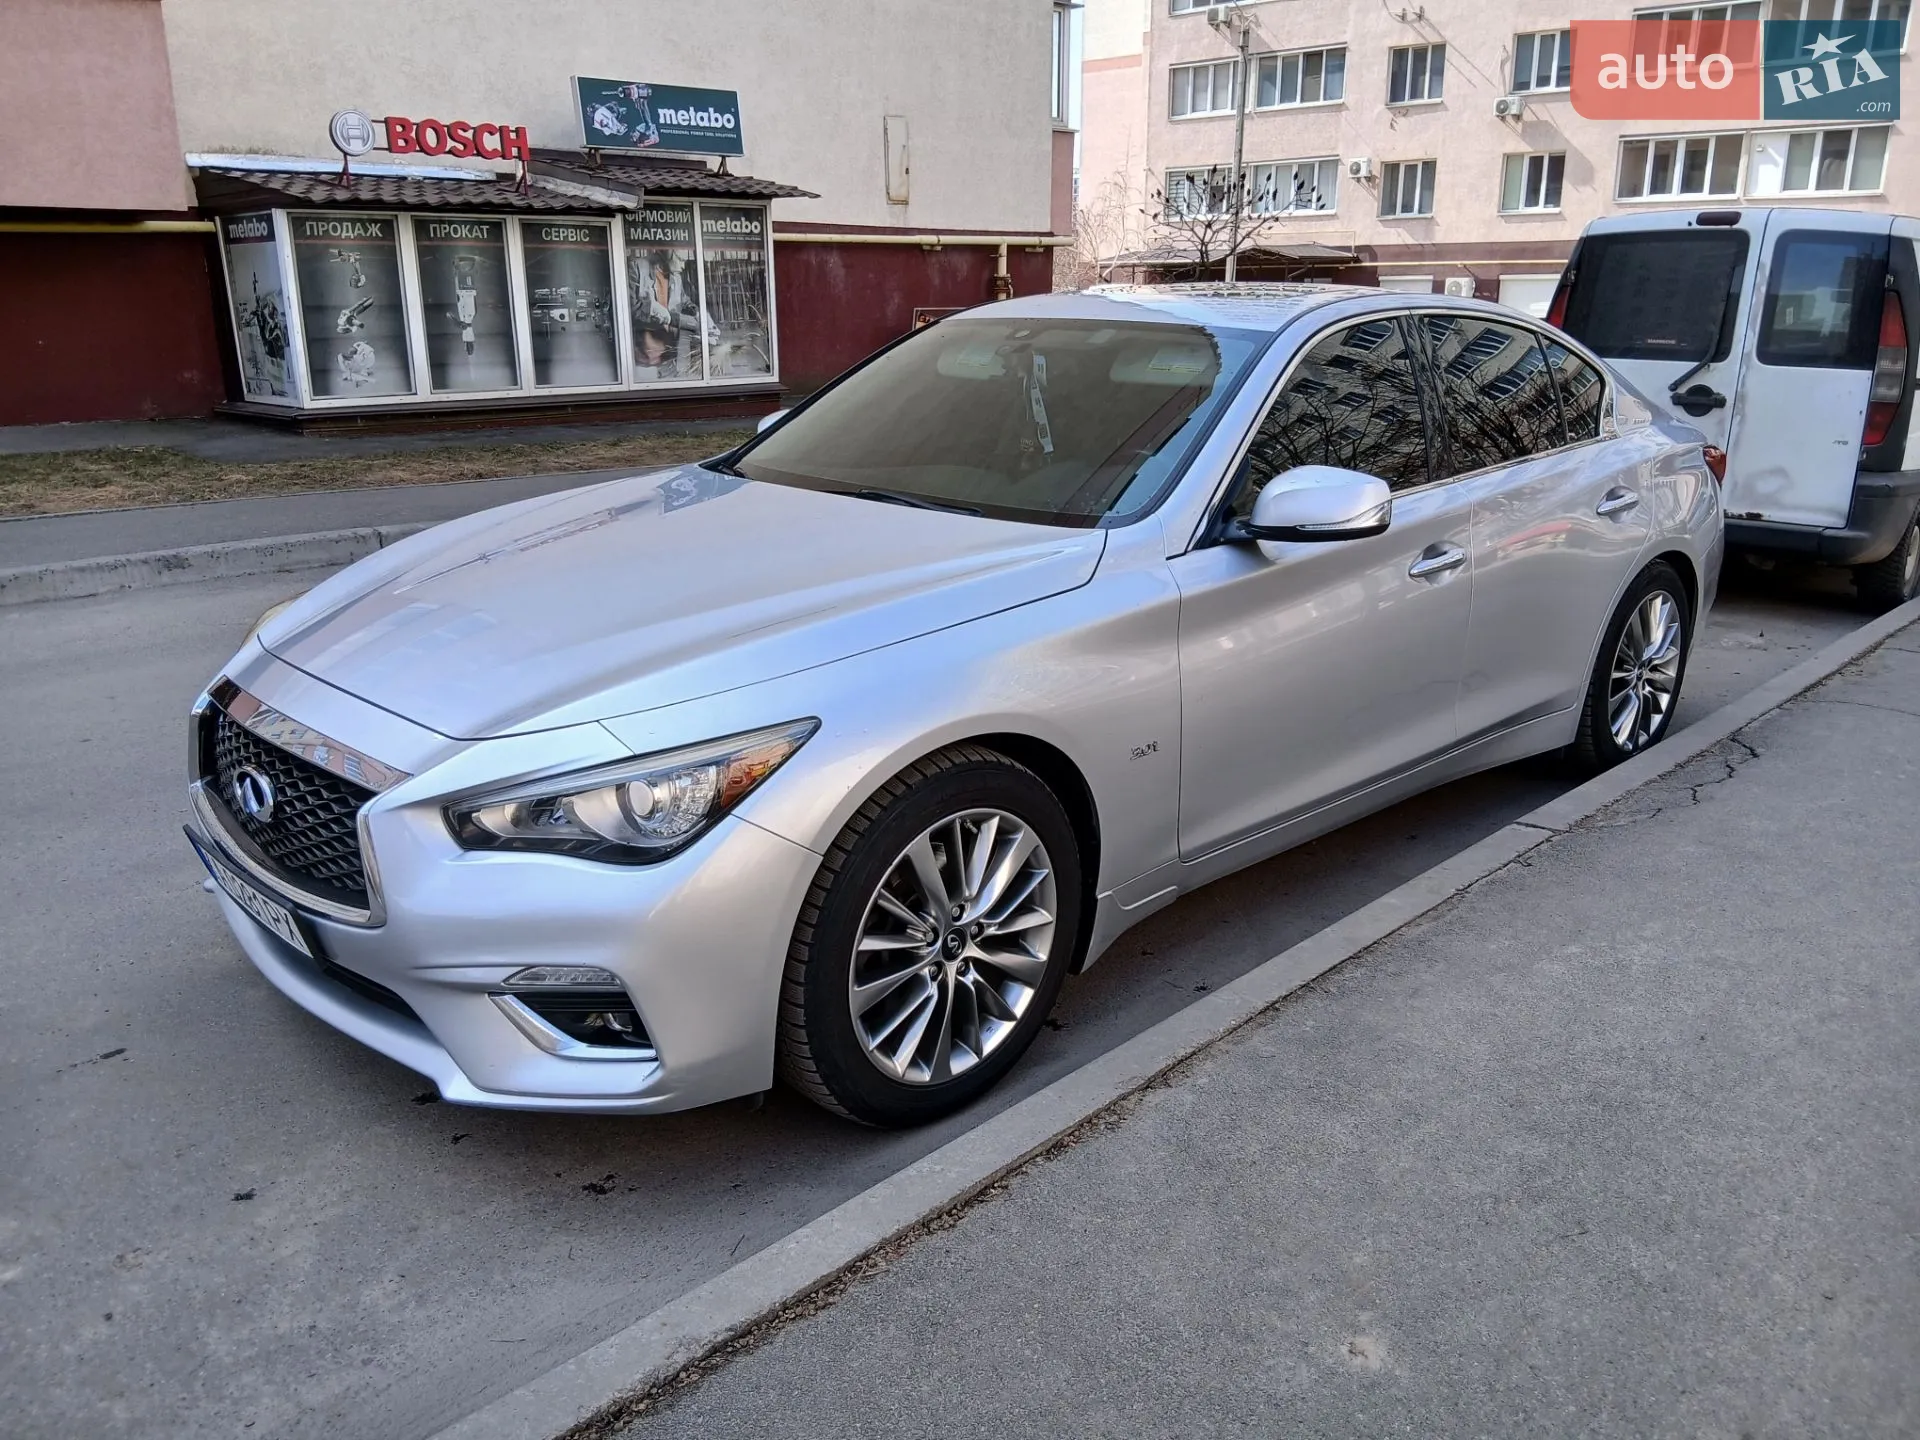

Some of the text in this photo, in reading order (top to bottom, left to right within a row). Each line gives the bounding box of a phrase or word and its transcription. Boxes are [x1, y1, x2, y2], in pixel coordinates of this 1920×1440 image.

[658, 106, 735, 129] metabo
[384, 116, 530, 161] BOSCH
[229, 217, 268, 239] metabo
[305, 221, 383, 239] ПРОДАЖ
[429, 223, 490, 239] ПРОКАТ
[702, 217, 761, 234] metabo
[541, 227, 590, 242] СЕРВІС
[630, 228, 689, 241] МАГАЗИН
